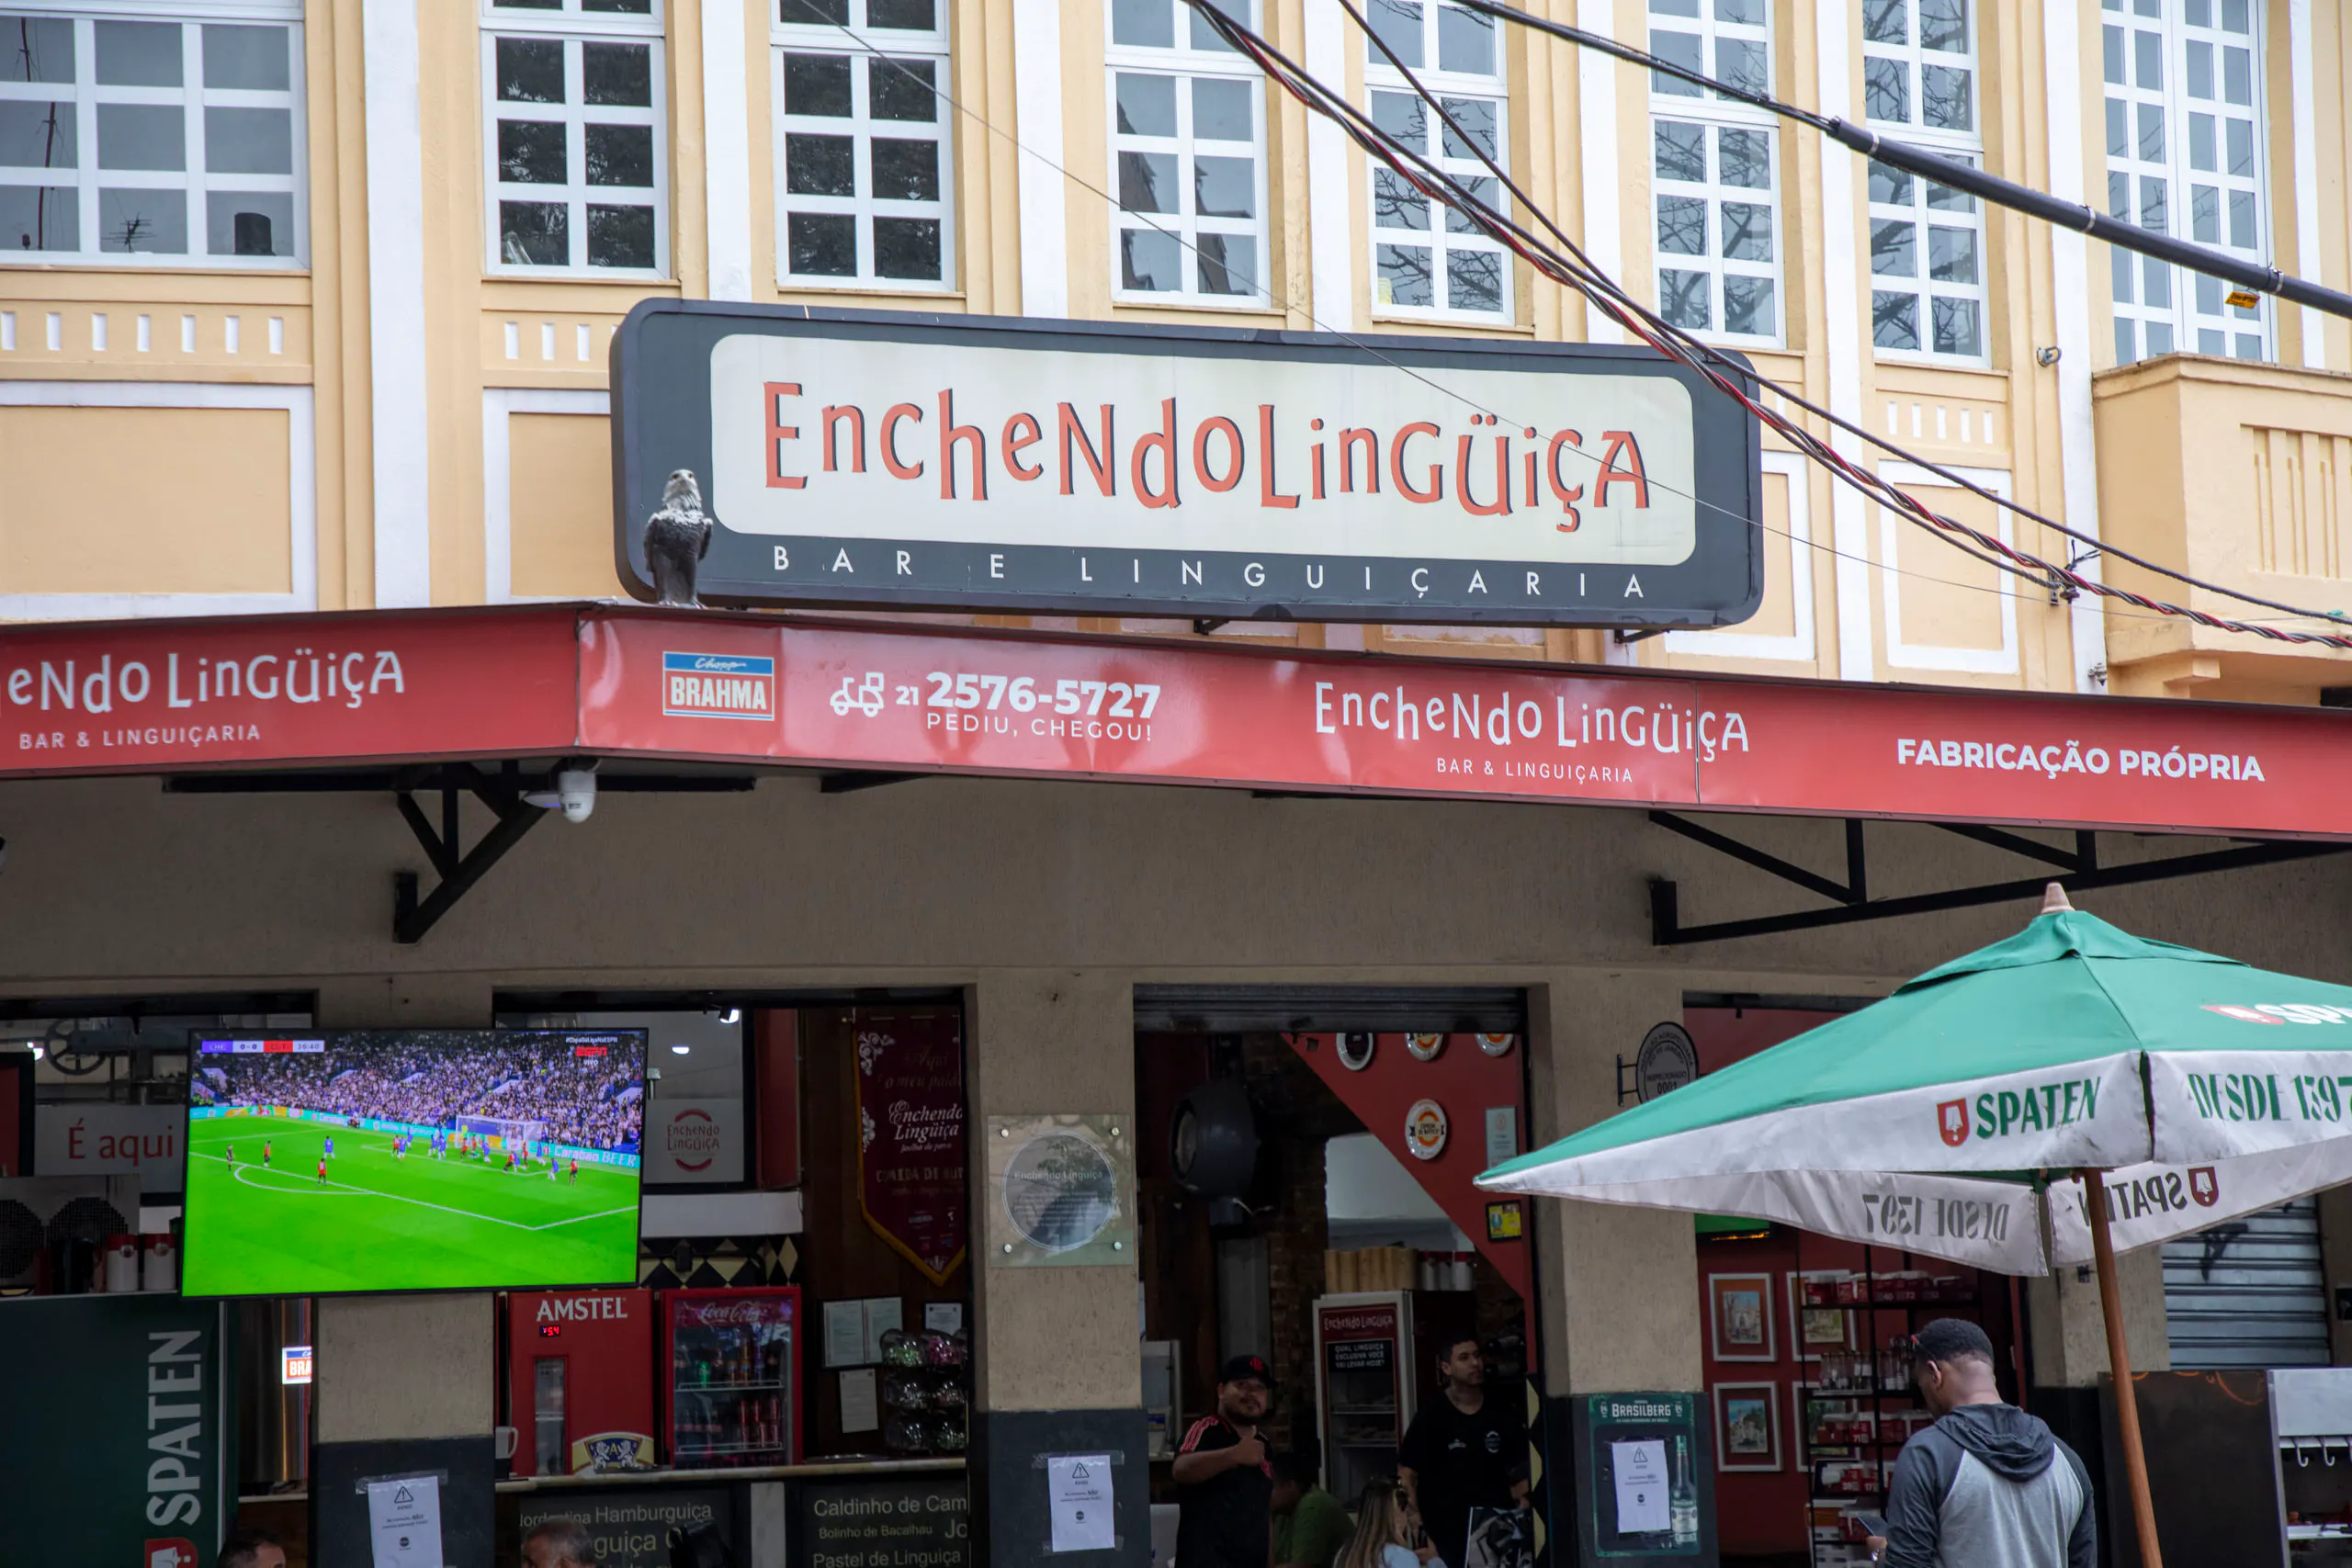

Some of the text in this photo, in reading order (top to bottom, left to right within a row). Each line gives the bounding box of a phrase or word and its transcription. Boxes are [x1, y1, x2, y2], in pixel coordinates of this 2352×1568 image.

[774, 546, 1645, 599] BAR E LINGUIÇARIA
[671, 676, 767, 710] BRAHMA
[895, 671, 1161, 719] 21 2576-5727
[19, 725, 261, 750] BAR & LINGUIÇARIA
[927, 712, 1152, 741] PEDIU, CHEGOU!
[1437, 758, 1634, 785] BAR & LINGUIÇARIA
[1897, 739, 2267, 783] FABRICAÇÃO PRÓPRIA
[1975, 1077, 2102, 1139] SPATEN
[2188, 1073, 2291, 1122] DESDE
[69, 1117, 173, 1167] É aqui
[536, 1296, 628, 1323] AMSTEL
[1611, 1403, 1672, 1418] BRASILBERG
[145, 1329, 201, 1527] SPATEN
[594, 1501, 713, 1534] Hamburguiça
[813, 1497, 893, 1517] Caldinho
[897, 1495, 921, 1514] de
[818, 1523, 933, 1540] Bolinho de Bacalhau
[812, 1548, 963, 1568] Pastel de Linguiça
